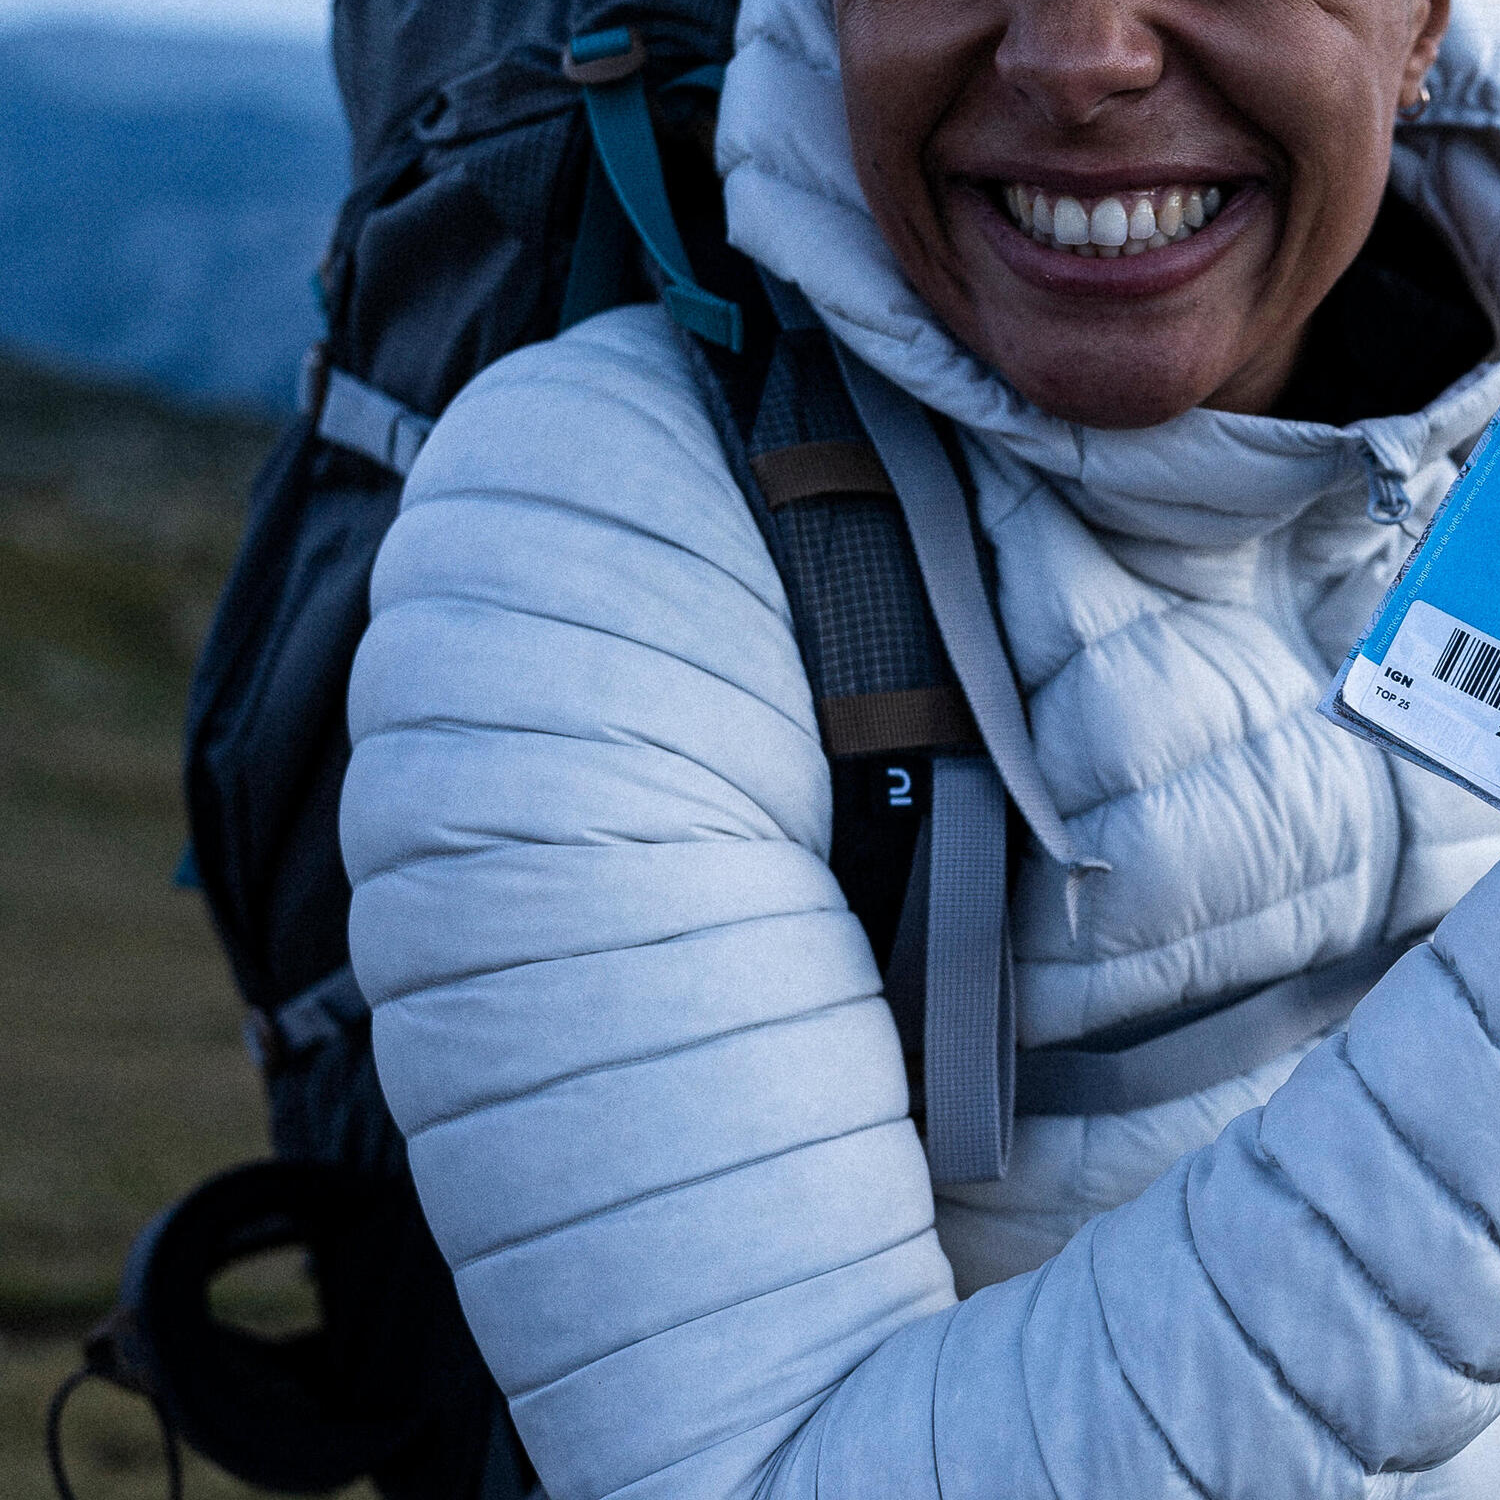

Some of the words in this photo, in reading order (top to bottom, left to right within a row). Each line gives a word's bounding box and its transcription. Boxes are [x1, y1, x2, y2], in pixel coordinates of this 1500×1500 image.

[1416, 560, 1434, 588] papier
[1431, 545, 1443, 562] issu
[1440, 532, 1450, 547] de
[1384, 667, 1414, 689] IGN
[1375, 685, 1398, 703] TOP
[1397, 698, 1411, 711] 25
